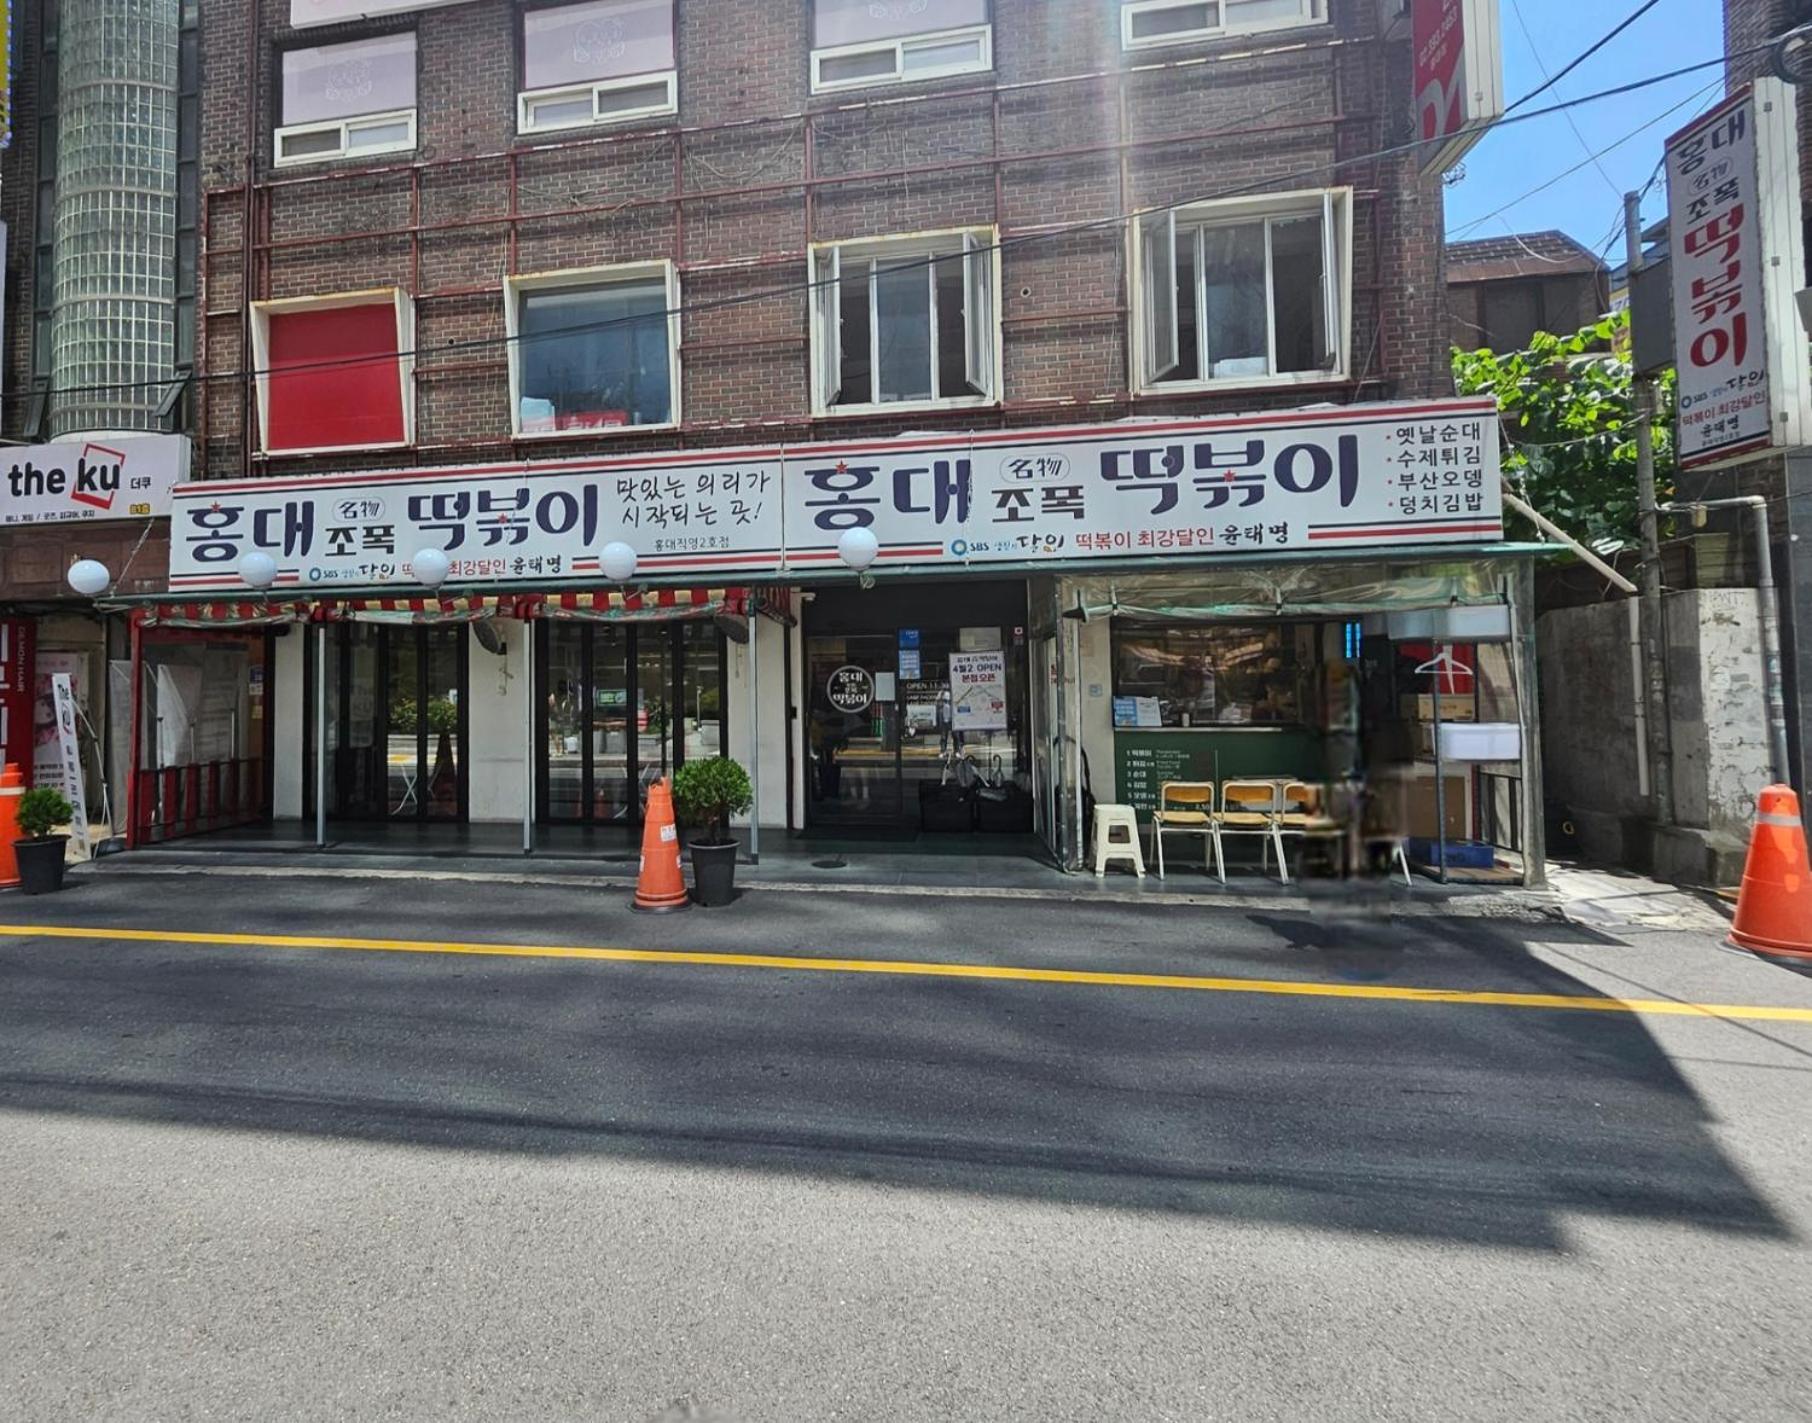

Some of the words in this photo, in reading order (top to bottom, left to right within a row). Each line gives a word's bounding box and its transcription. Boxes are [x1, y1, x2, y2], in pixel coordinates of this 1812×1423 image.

[1676, 109, 1745, 175] 홍대
[1686, 176, 1740, 225] 조폭
[1684, 203, 1748, 368] 떡볶이
[1396, 422, 1480, 445] 옛날순대
[1007, 455, 1062, 479] 名物
[1397, 446, 1480, 469] 수제튀김
[8, 462, 66, 497] the
[78, 457, 120, 492] ku
[131, 477, 152, 490] 더쿠
[617, 475, 686, 502] 맛있는
[697, 470, 771, 496] 의리가
[804, 459, 971, 531] 홍대
[991, 485, 1084, 523] 조폭
[1100, 433, 1359, 516] 떡볶이
[1398, 469, 1482, 492] 부산오뎅
[339, 500, 380, 519] 名物
[622, 503, 717, 529] 시작되는
[731, 499, 762, 526] 곳!
[1400, 493, 1484, 515] 덩치김밥
[186, 501, 314, 562] 홍대
[325, 525, 395, 557] 조폭
[408, 484, 598, 551] 떡볶이
[654, 535, 729, 552] 홍대직영2호점
[969, 542, 989, 552] SBS
[1076, 531, 1131, 550] 떡볶이
[1137, 527, 1215, 548] 최강달인
[976, 662, 1002, 673] OPEN
